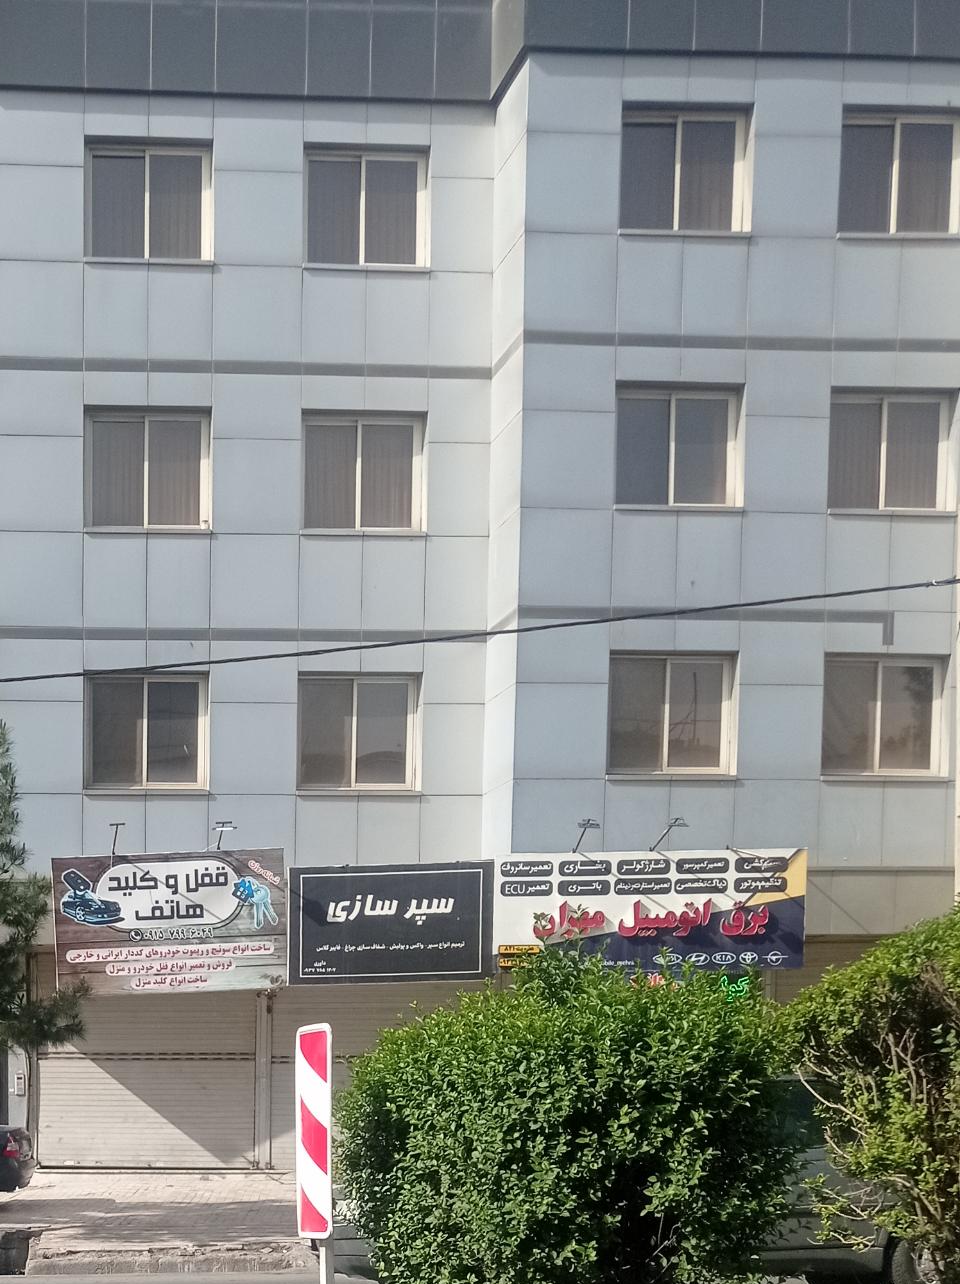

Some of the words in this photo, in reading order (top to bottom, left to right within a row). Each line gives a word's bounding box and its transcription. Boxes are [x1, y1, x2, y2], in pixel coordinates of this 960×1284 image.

[501, 863, 531, 874] سانروف
[530, 862, 553, 874] تعمیر
[563, 860, 606, 874] بخاری
[621, 859, 646, 872] کولر
[644, 858, 666, 872] شارژ
[706, 860, 725, 869] تعمیر
[107, 869, 158, 897] کلید
[165, 874, 178, 896] و
[186, 866, 229, 893] قفل
[739, 880, 760, 890] موتور
[759, 879, 782, 890] تنظیم
[505, 884, 526, 895] ECU
[526, 883, 550, 893] تعمیر
[567, 882, 602, 893] باتری
[134, 899, 205, 921] هاتف
[326, 893, 399, 923] سازی
[403, 897, 455, 926] سپر
[617, 898, 712, 937] اتومبیل
[720, 900, 769, 936] برق
[124, 949, 144, 959] کددار
[145, 948, 180, 959] خودروهای
[183, 948, 204, 958] ریموت
[232, 945, 249, 955] انواع
[250, 944, 270, 953] ساخت
[69, 951, 94, 962] خارجی
[101, 950, 123, 960] ایرانی
[109, 965, 125, 974] منزل
[133, 965, 154, 974] خودرو
[170, 962, 187, 972] انواع
[188, 962, 205, 971] تعمیر
[212, 961, 233, 971] فروش
[135, 978, 151, 988] منزل
[152, 977, 167, 986] کلید
[169, 977, 187, 986] انواع
[187, 976, 208, 984] ساخت
